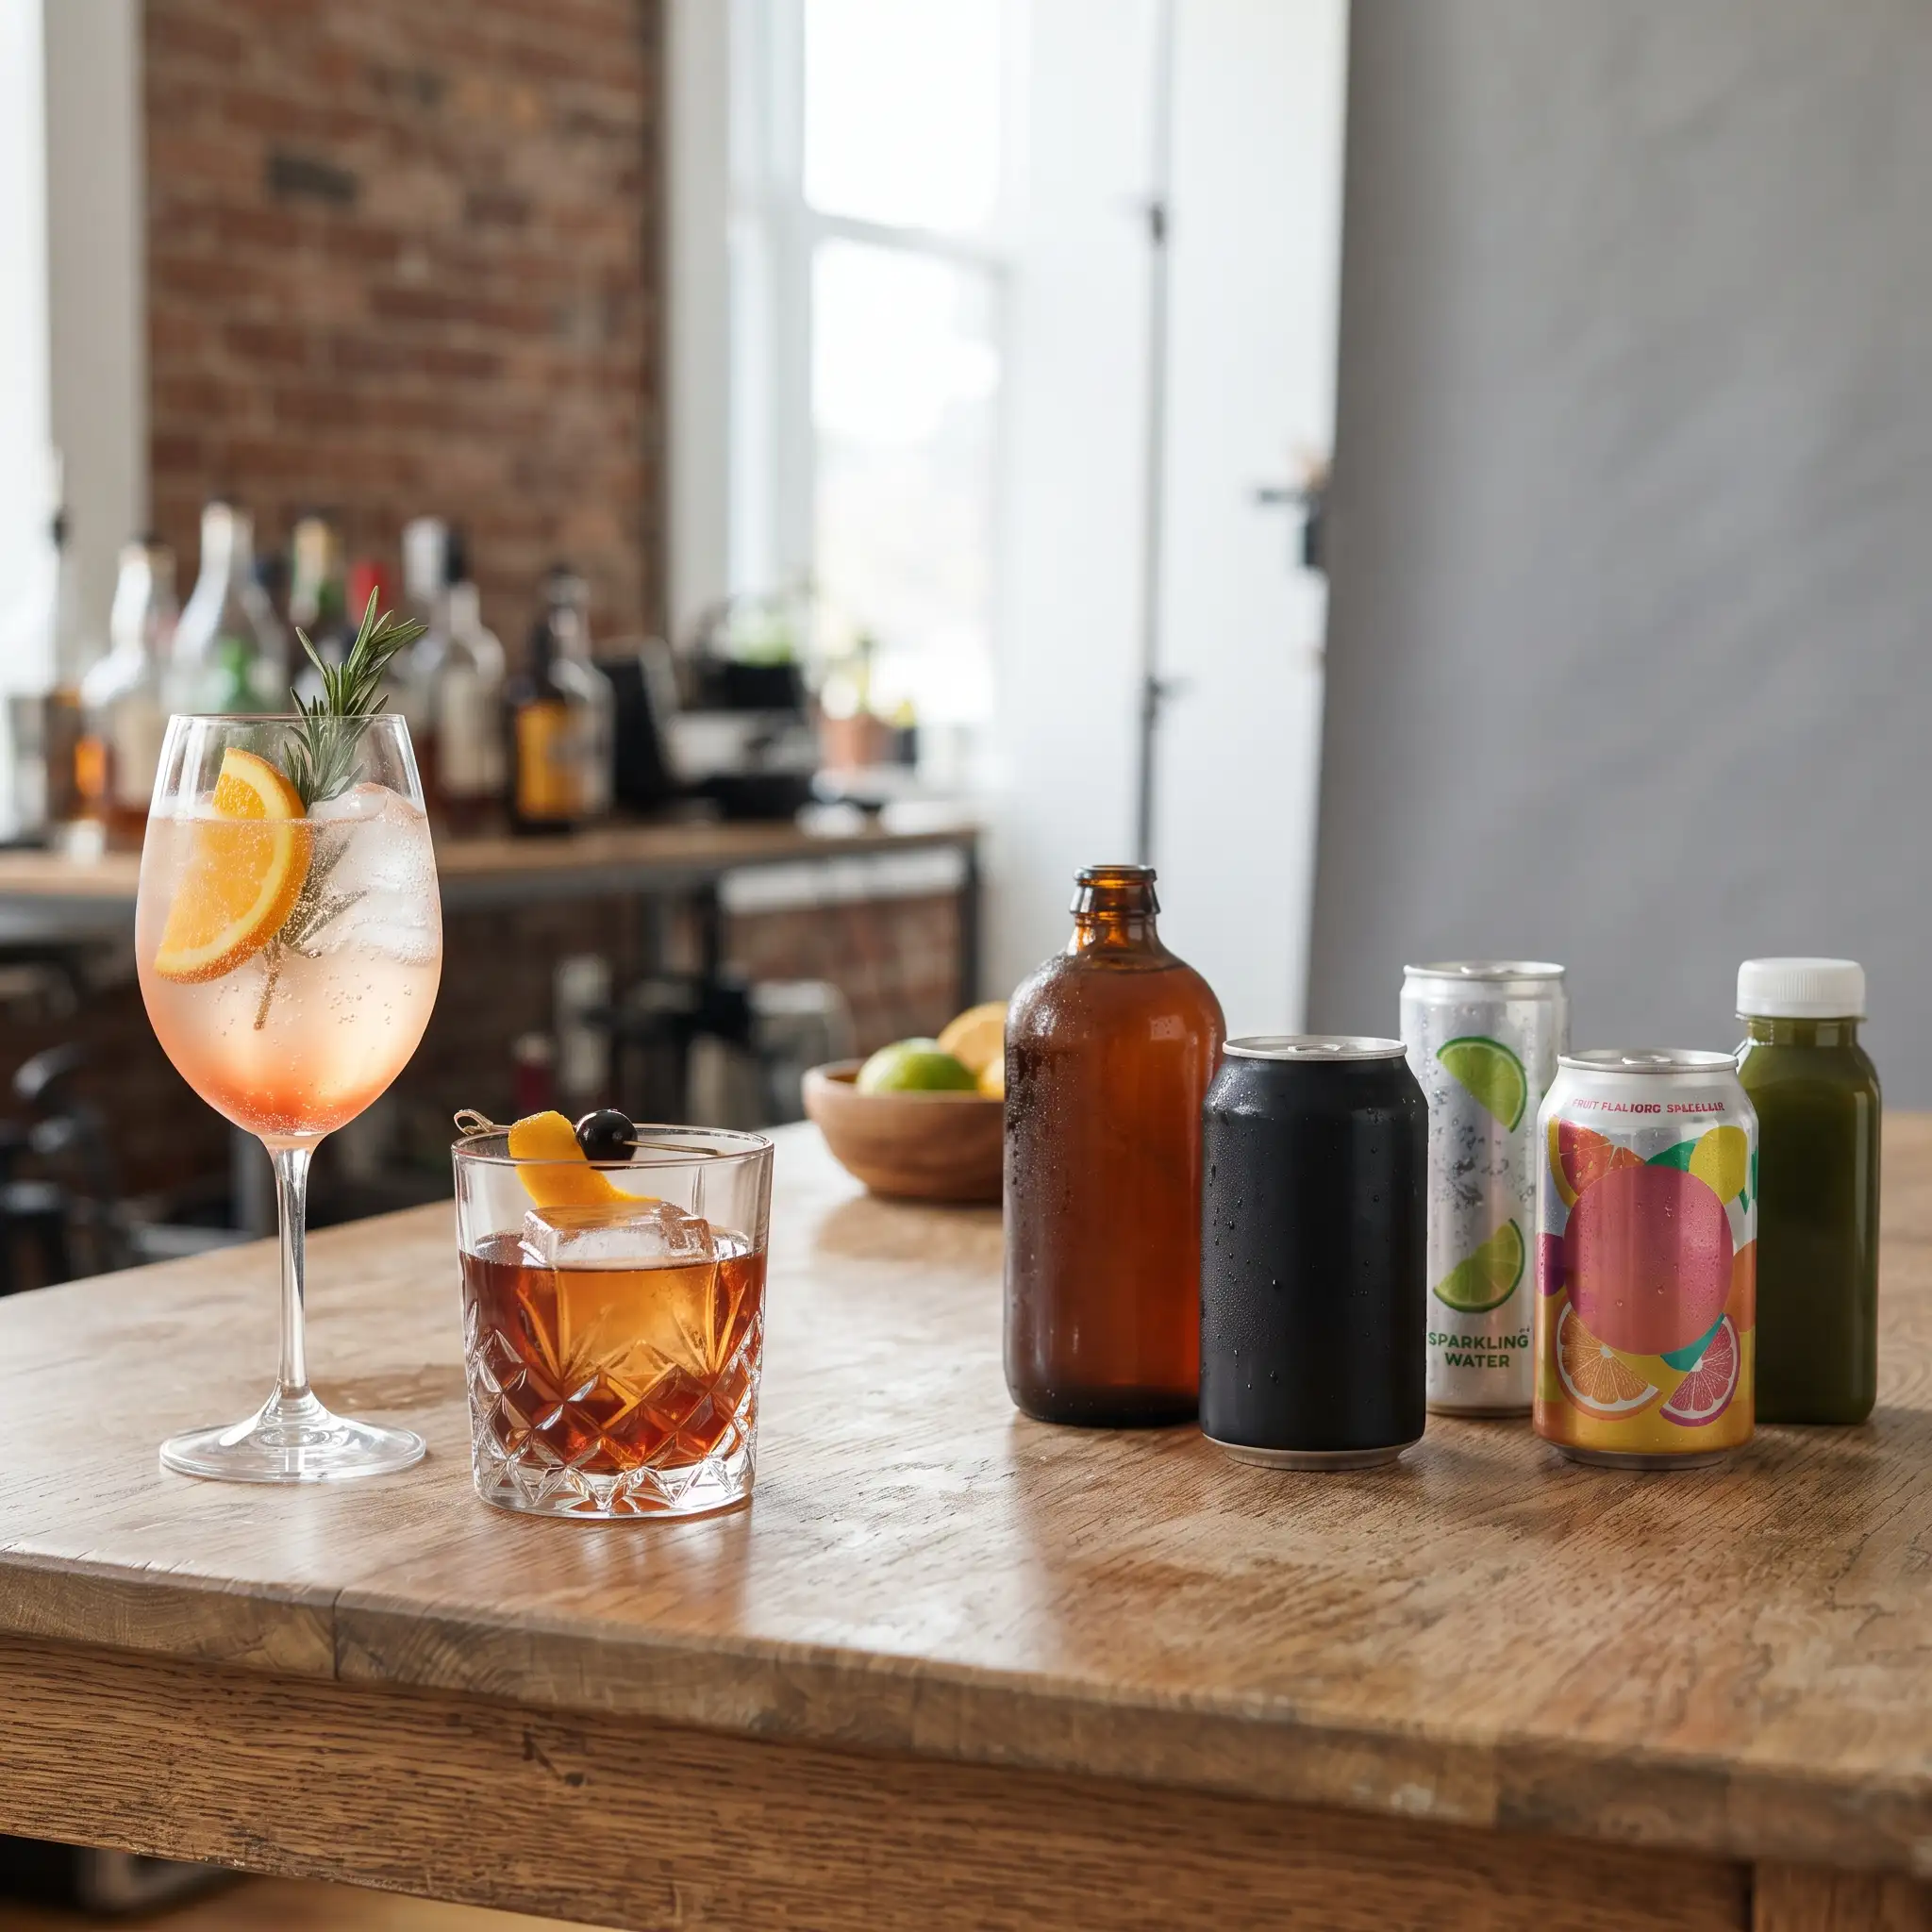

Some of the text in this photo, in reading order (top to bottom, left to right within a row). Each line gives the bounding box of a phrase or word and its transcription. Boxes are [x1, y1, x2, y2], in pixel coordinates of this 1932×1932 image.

[1572, 1098, 1599, 1110] FRUIT
[1428, 1331, 1529, 1349] SPARKLING
[1444, 1352, 1510, 1368] WATER
